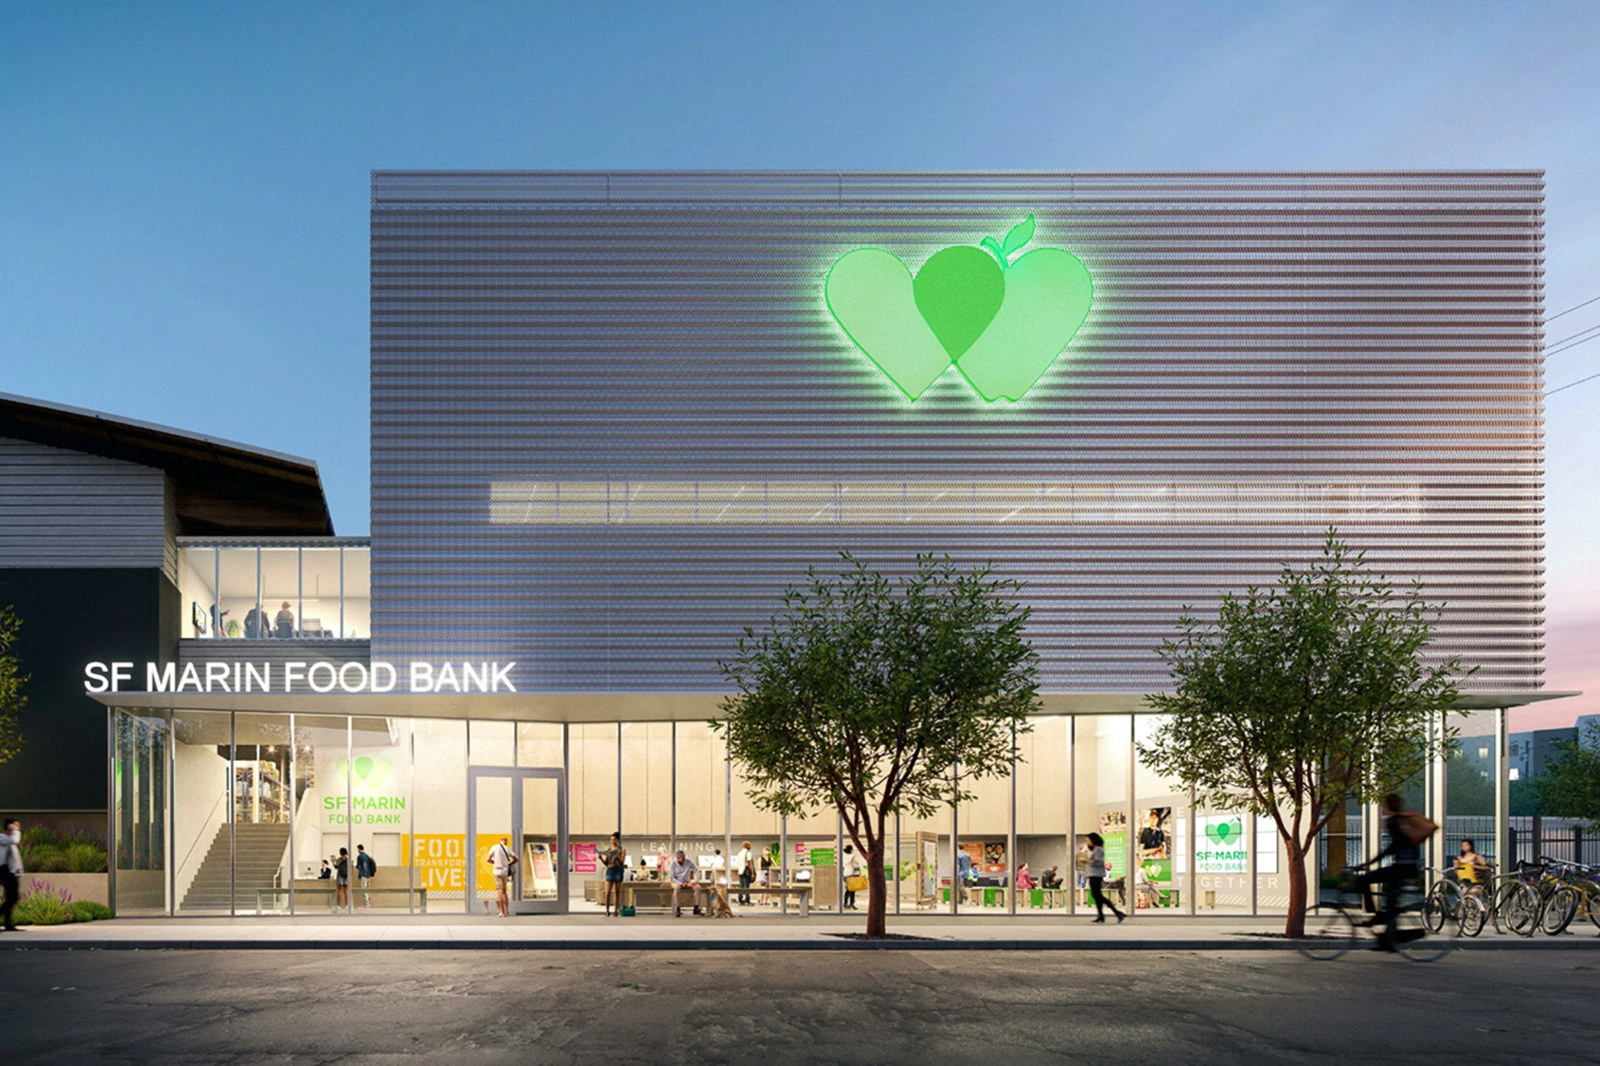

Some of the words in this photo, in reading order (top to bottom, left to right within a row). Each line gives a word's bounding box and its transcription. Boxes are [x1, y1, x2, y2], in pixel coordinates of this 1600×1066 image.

[84, 661, 134, 692] SF
[147, 662, 270, 692] MARIN
[285, 661, 397, 692] FOOD
[410, 662, 517, 692] BANK
[323, 796, 347, 810] SF
[353, 796, 406, 810] MARIN
[367, 813, 401, 825] BANK
[413, 839, 466, 858] FOO
[641, 842, 715, 852] LEANING
[1199, 862, 1223, 871] FOOD
[1225, 862, 1247, 871] BAN
[421, 868, 466, 888] IVE
[1177, 876, 1279, 889] TGETHER
